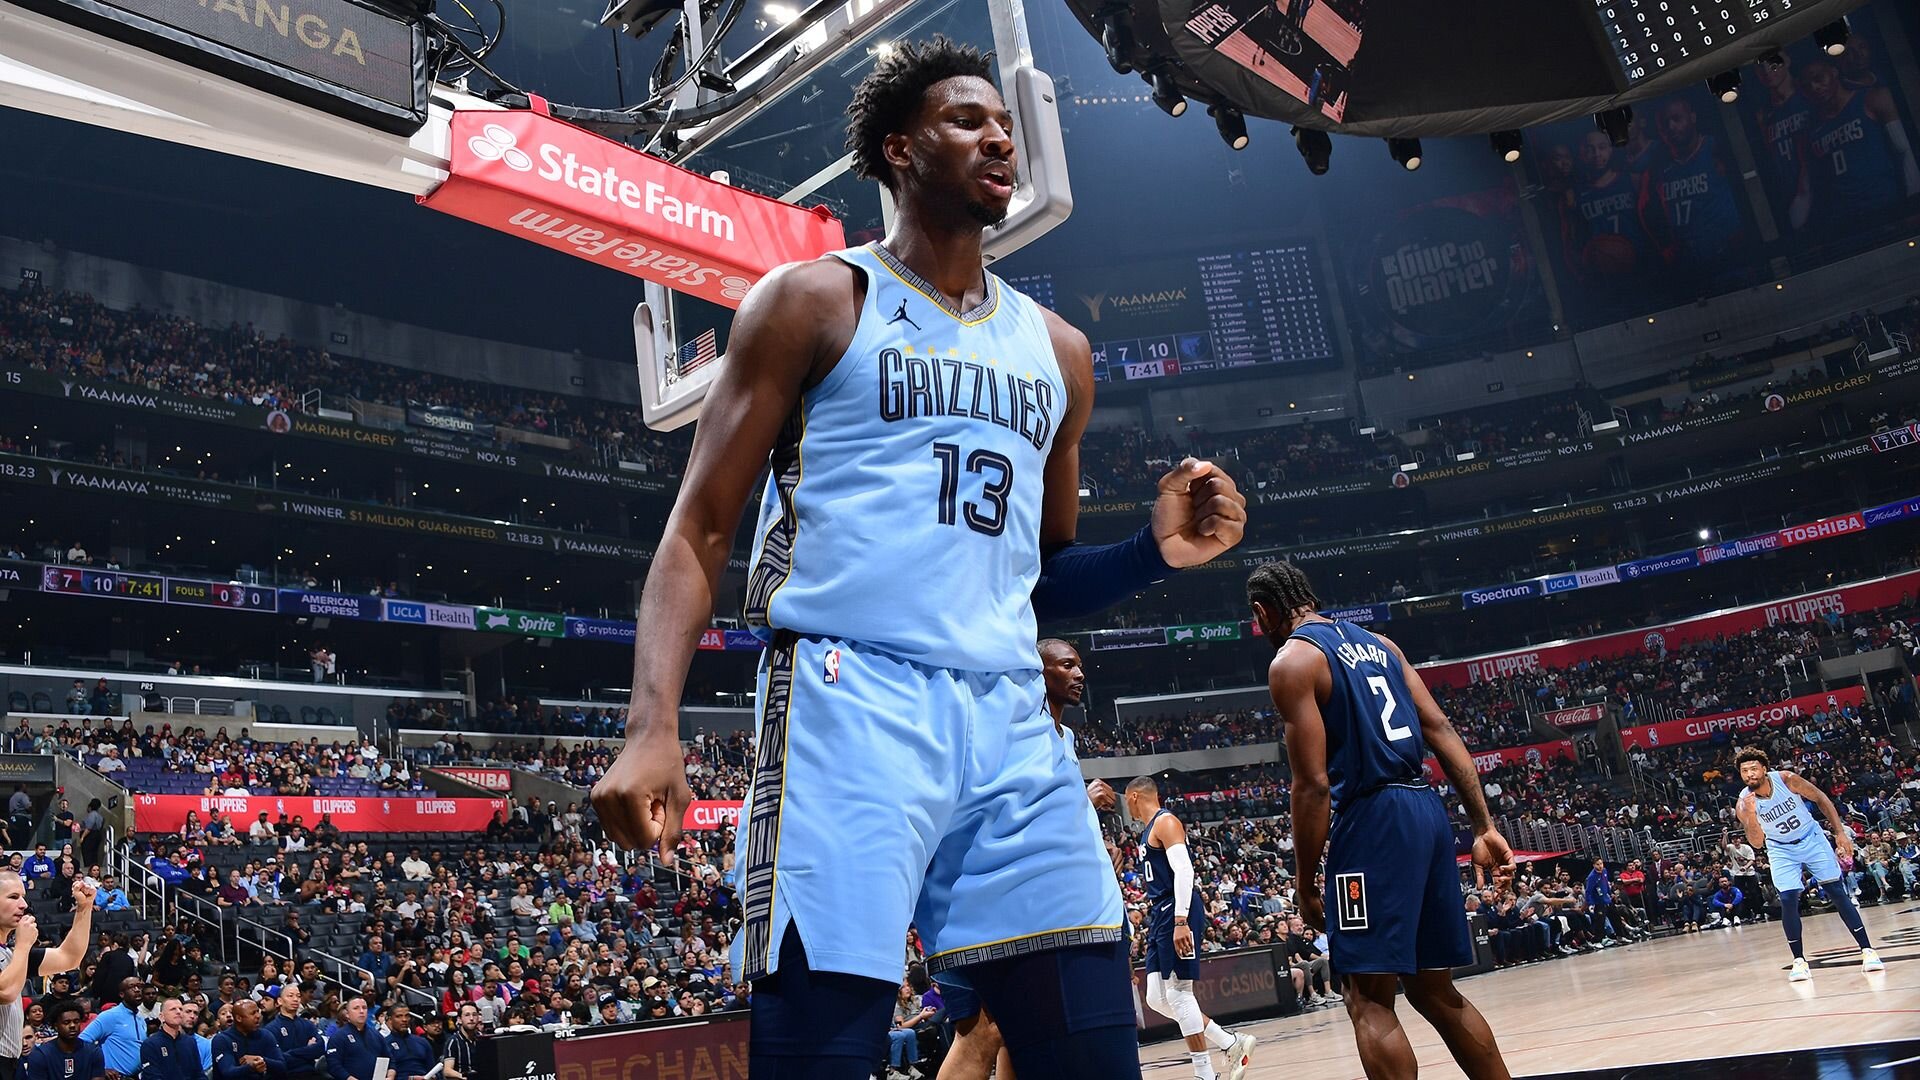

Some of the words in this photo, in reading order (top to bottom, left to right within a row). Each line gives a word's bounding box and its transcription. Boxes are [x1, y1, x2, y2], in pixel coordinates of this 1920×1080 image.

[1607, 9, 1615, 19] 0
[1660, 2, 1668, 11] 0
[1614, 24, 1622, 34] 1
[1637, 13, 1645, 22] 0
[1691, 5, 1698, 14] 1
[200, 0, 366, 66] ANGA
[1620, 39, 1628, 48] 2
[1644, 28, 1652, 37] 2
[1666, 16, 1674, 26] 0
[1624, 53, 1638, 66] 13
[1651, 43, 1658, 52] 0
[1674, 32, 1681, 42] 0
[1698, 21, 1706, 30] 1
[1721, 10, 1728, 20] 0
[1630, 67, 1645, 78] 40
[1657, 58, 1665, 67] 0
[1680, 48, 1688, 57] 1
[1704, 36, 1712, 46] 0
[1728, 24, 1735, 34] 0
[1753, 9, 1769, 22] 36
[24, 270, 38, 279] 301
[1118, 347, 1128, 361] 7
[1148, 342, 1168, 358] 10
[1130, 363, 1159, 376] 7:41
[6, 372, 21, 384] 15
[1786, 385, 1832, 403] MARIAH
[1834, 373, 1872, 391] CAREY
[878, 348, 1052, 450] GRIZZLIES
[424, 412, 474, 431] Spectrum
[295, 421, 349, 439] MARIAH
[354, 430, 396, 446] CAREY
[1900, 435, 1908, 444] 0
[1558, 445, 1580, 456] NOV.
[1583, 442, 1593, 450] 15
[1827, 444, 1872, 460] WINNER.
[1882, 440, 1889, 448] 7
[477, 451, 502, 464] NOV.
[505, 456, 517, 467] 15
[1412, 468, 1454, 483] MARIAH
[1456, 461, 1490, 474] CAREY
[932, 442, 1013, 536] 13
[1104, 502, 1137, 512] CAREY
[283, 502, 288, 511] 1
[292, 502, 346, 519] WINNER.
[367, 514, 414, 528] MILLION
[418, 520, 498, 539] GUARANTEED.
[506, 532, 544, 545] 12.18.23
[1440, 528, 1482, 541] WINNER.
[1497, 517, 1536, 531] MILLION
[1538, 505, 1606, 524] GUARANTEED.
[1613, 497, 1647, 510] 12.18.23
[1782, 517, 1861, 543] TOSHIBA
[1703, 547, 1726, 562] Give
[1726, 547, 1736, 556] no
[1735, 535, 1777, 556] Quarter
[1641, 556, 1690, 572] crypto.com
[63, 574, 73, 587] 7
[94, 577, 112, 591] 10
[1550, 579, 1574, 589] UCLA
[1580, 571, 1615, 585] Health
[128, 581, 160, 596] 7:41
[176, 586, 205, 597] FOULS
[220, 590, 229, 602] 0
[1471, 586, 1530, 605] Spectrum
[252, 592, 260, 605] 0
[301, 594, 359, 608] AMERICAN
[309, 604, 360, 616] EXPRESS
[392, 606, 422, 619] UCLA
[430, 609, 471, 624] Health
[1330, 608, 1372, 619] AMERICAN
[1781, 594, 1845, 624] CLIPPERS
[518, 616, 556, 632] Sprite
[589, 626, 636, 636] crypto.com
[1200, 626, 1231, 640] Sprite
[1482, 653, 1539, 682] CLIPPERS
[1366, 676, 1412, 741] 2
[1686, 704, 1799, 737] CLIPPERS.COM
[140, 794, 156, 805] 101
[210, 798, 247, 812] CLIPPERS
[322, 800, 356, 814] CLIPPERS
[425, 801, 456, 814] CLIPPERS
[1760, 796, 1796, 824] GRIZZLIES
[1775, 815, 1801, 835] 36
[1220, 971, 1275, 997] CASINO
[555, 1028, 576, 1038] anc
